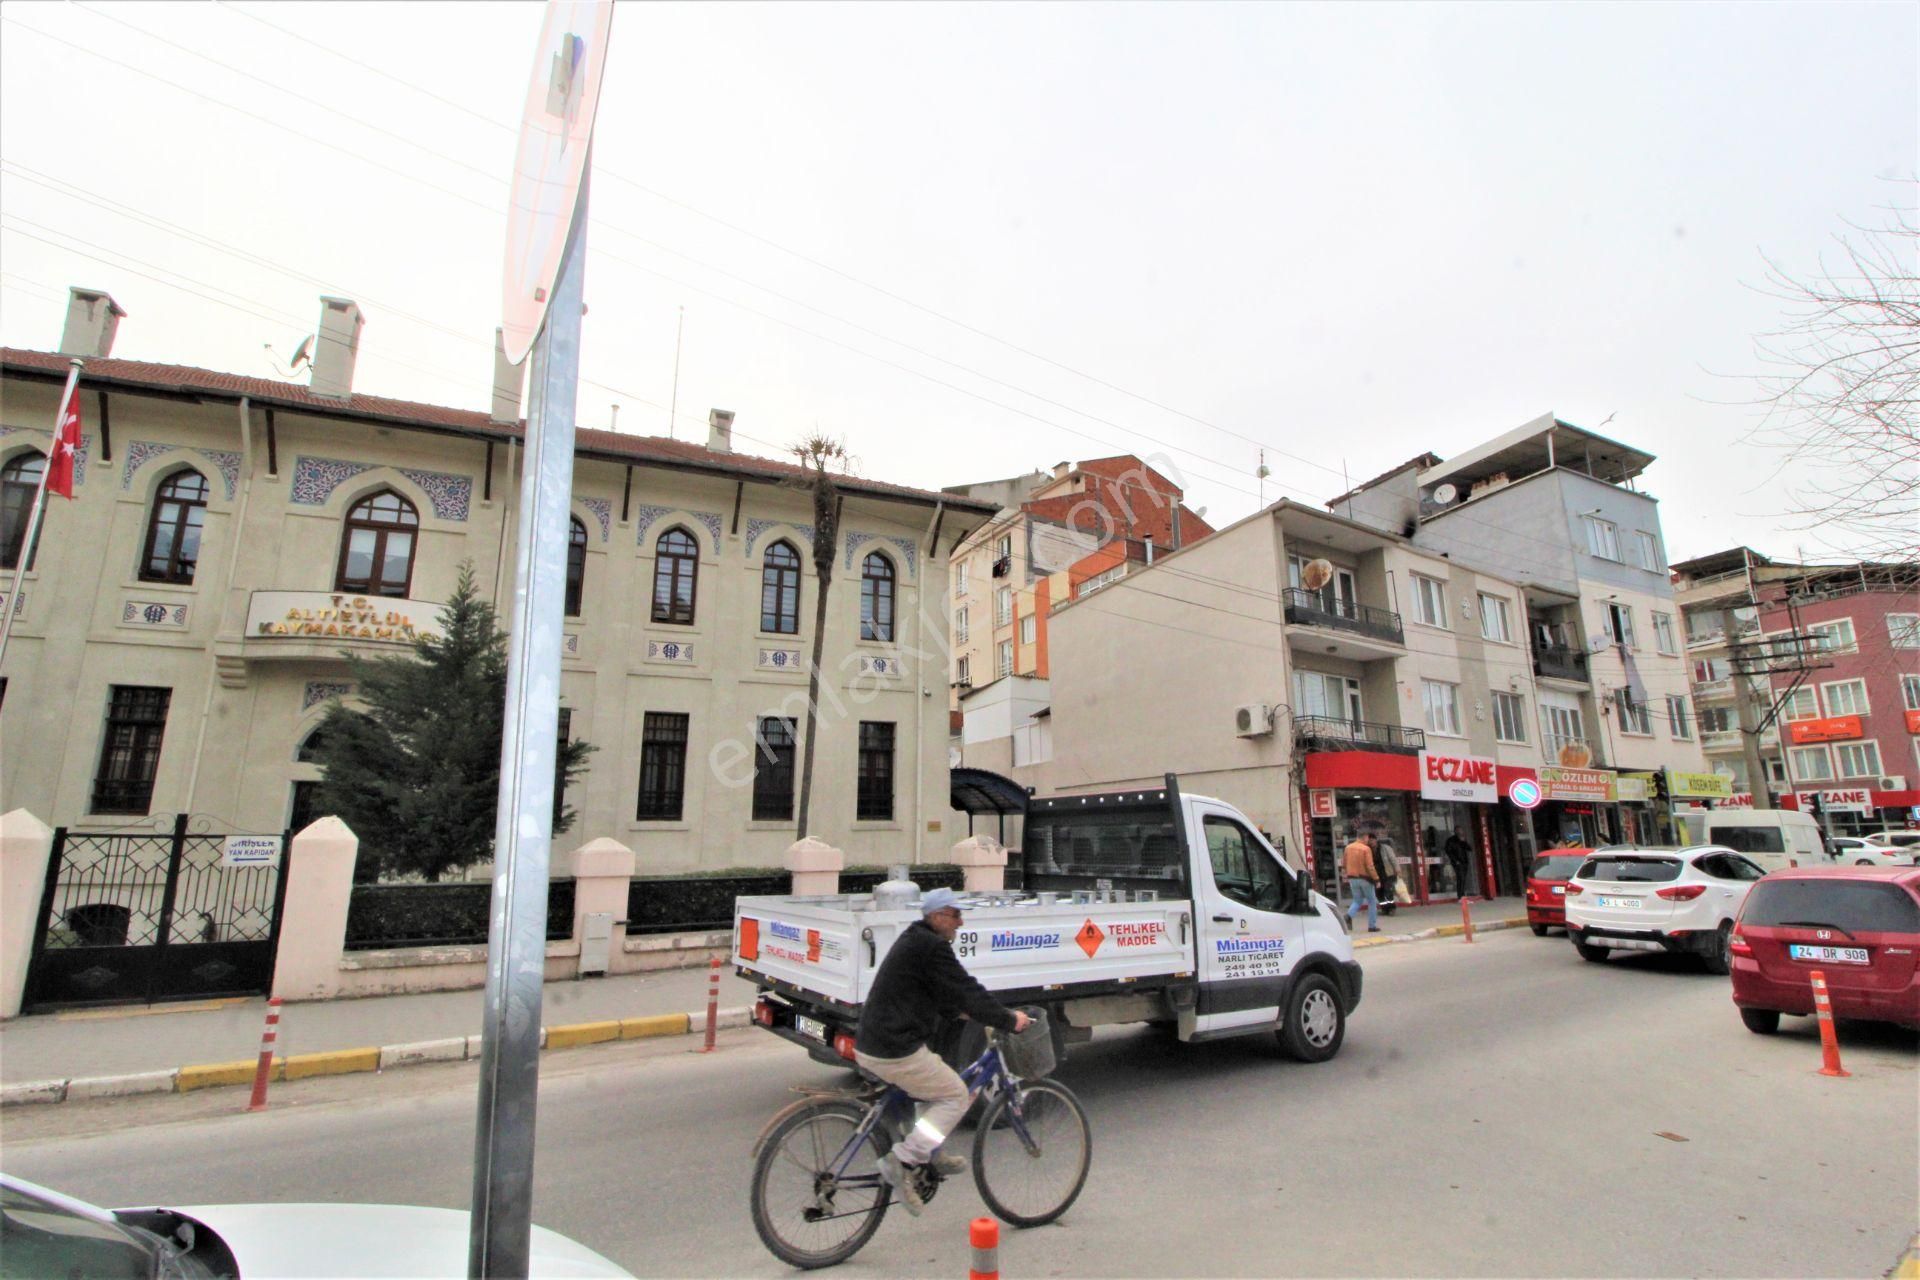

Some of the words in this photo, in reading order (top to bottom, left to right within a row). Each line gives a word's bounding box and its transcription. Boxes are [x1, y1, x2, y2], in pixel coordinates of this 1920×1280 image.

[330, 596, 374, 609] T.C.
[1426, 755, 1496, 785] ECZANE
[1561, 770, 1597, 785] ÖZLEM
[1315, 792, 1330, 813] E
[960, 932, 978, 944] 90
[992, 930, 1060, 949] Milangaz
[1117, 935, 1157, 947] MADDE
[1216, 938, 1285, 952] Milangaz
[959, 946, 976, 957] 91
[1799, 946, 1813, 957] 24
[1823, 948, 1838, 959] DR
[1844, 949, 1867, 961] 908
[1225, 964, 1245, 972] 249
